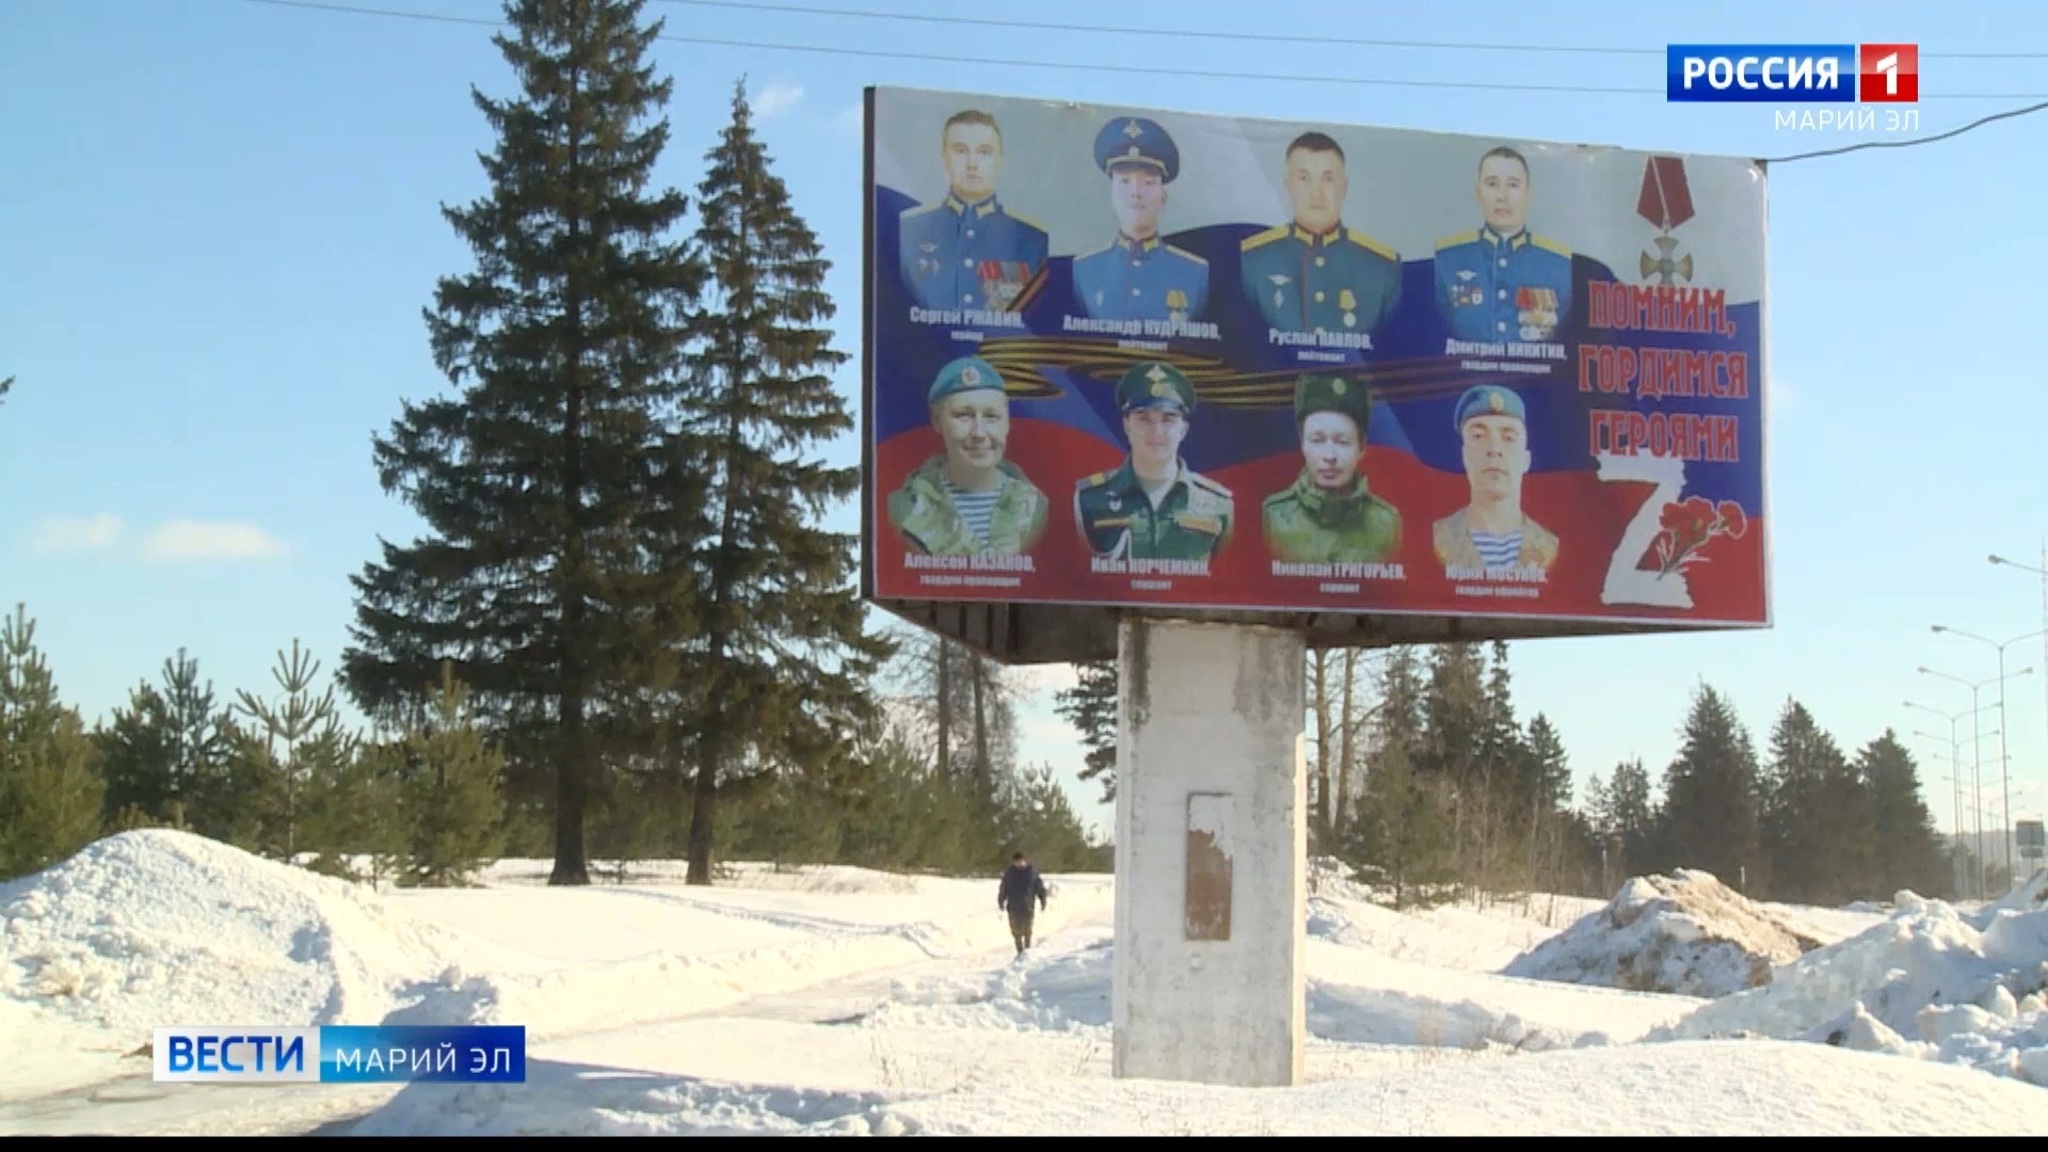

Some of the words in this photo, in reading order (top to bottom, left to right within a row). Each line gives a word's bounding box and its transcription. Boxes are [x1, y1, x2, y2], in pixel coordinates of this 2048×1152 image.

[1587, 280, 1736, 338] ПОМНИМ,
[1063, 314, 1142, 336] Александр
[1269, 327, 1317, 346] Руслан
[1445, 338, 1505, 356] Дмитрий
[1578, 344, 1748, 399] ГОРДИМСЯ
[1589, 409, 1739, 462] ГЕРОЯМИ
[1091, 556, 1126, 573] Иван
